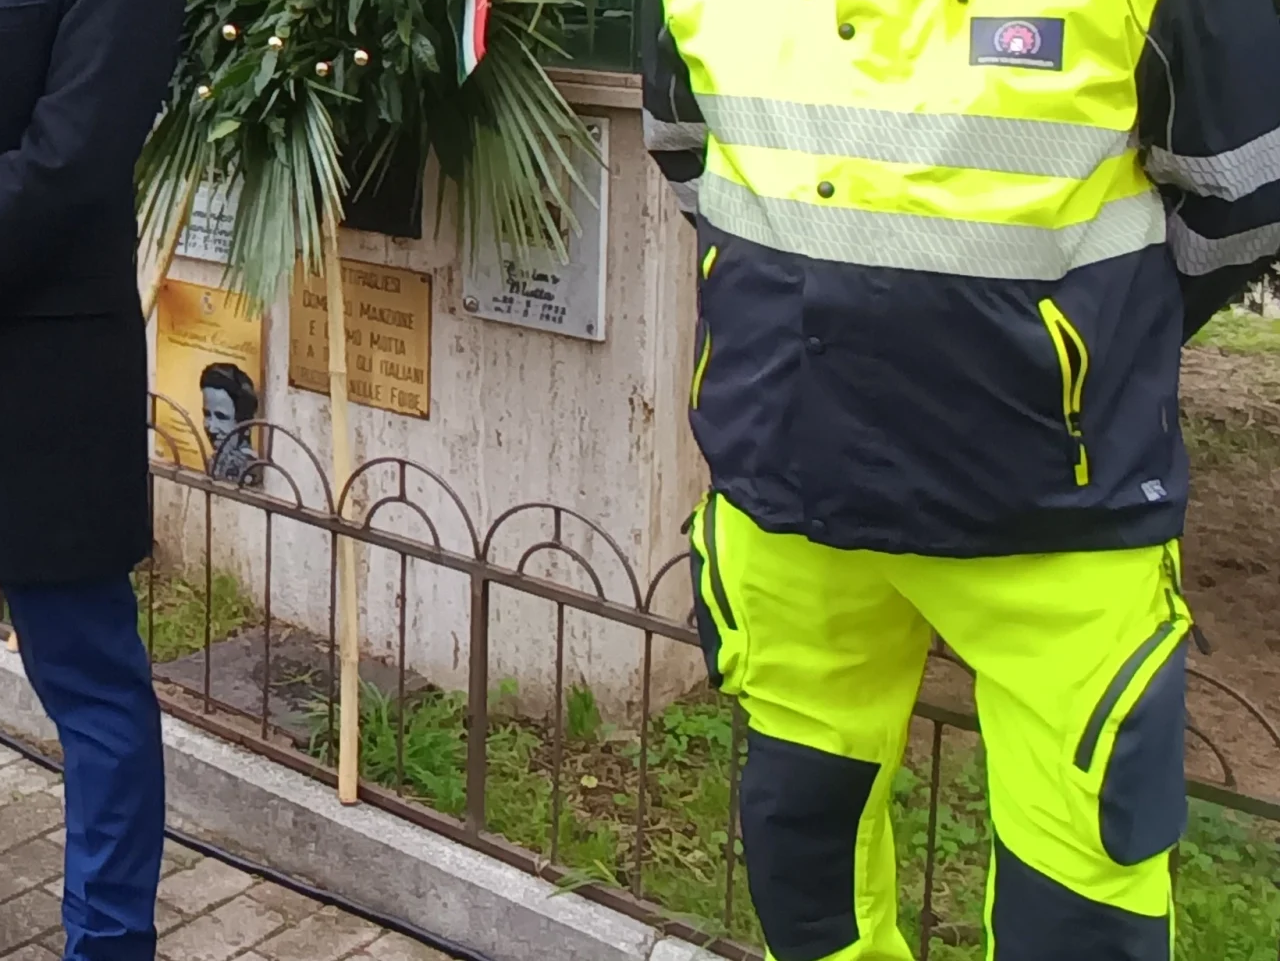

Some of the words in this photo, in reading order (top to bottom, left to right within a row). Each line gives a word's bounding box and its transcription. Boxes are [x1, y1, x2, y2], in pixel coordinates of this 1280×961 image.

[308, 319, 316, 336] E
[369, 331, 406, 356] MOTTA
[379, 359, 425, 385] ITALIANI
